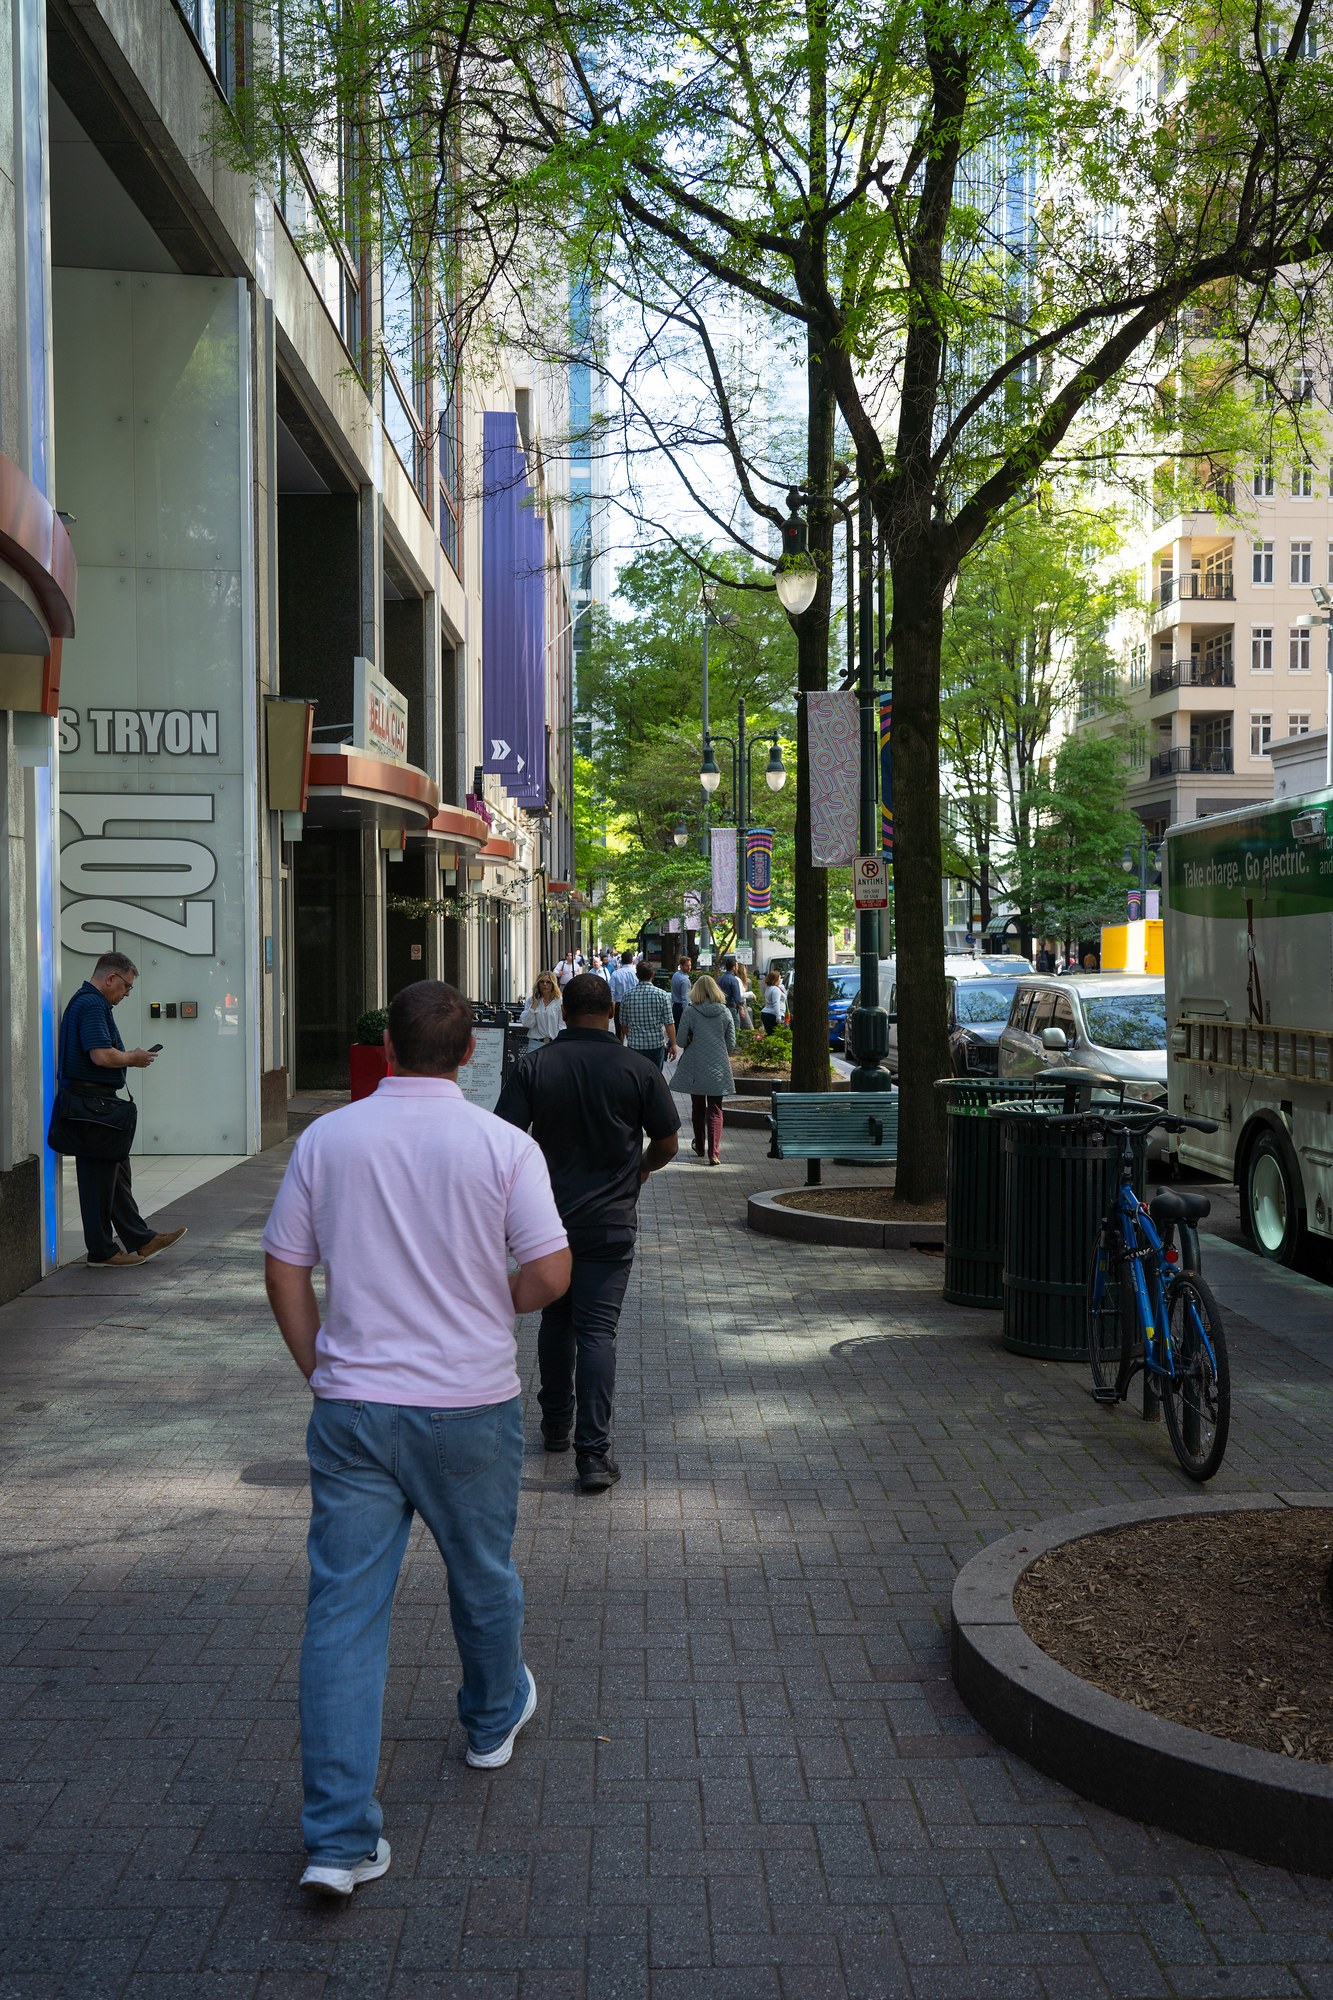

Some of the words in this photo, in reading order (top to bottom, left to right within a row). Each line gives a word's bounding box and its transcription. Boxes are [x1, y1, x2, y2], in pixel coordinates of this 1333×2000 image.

[59, 707, 80, 754] S
[87, 708, 219, 756] TRYON
[369, 692, 389, 743] BELLA
[59, 791, 218, 957] 201
[858, 878, 884, 886] ANYTIME
[1183, 861, 1204, 889] Take
[1206, 858, 1241, 890] charge.
[1245, 851, 1260, 881] Go
[1263, 843, 1310, 878] electric.
